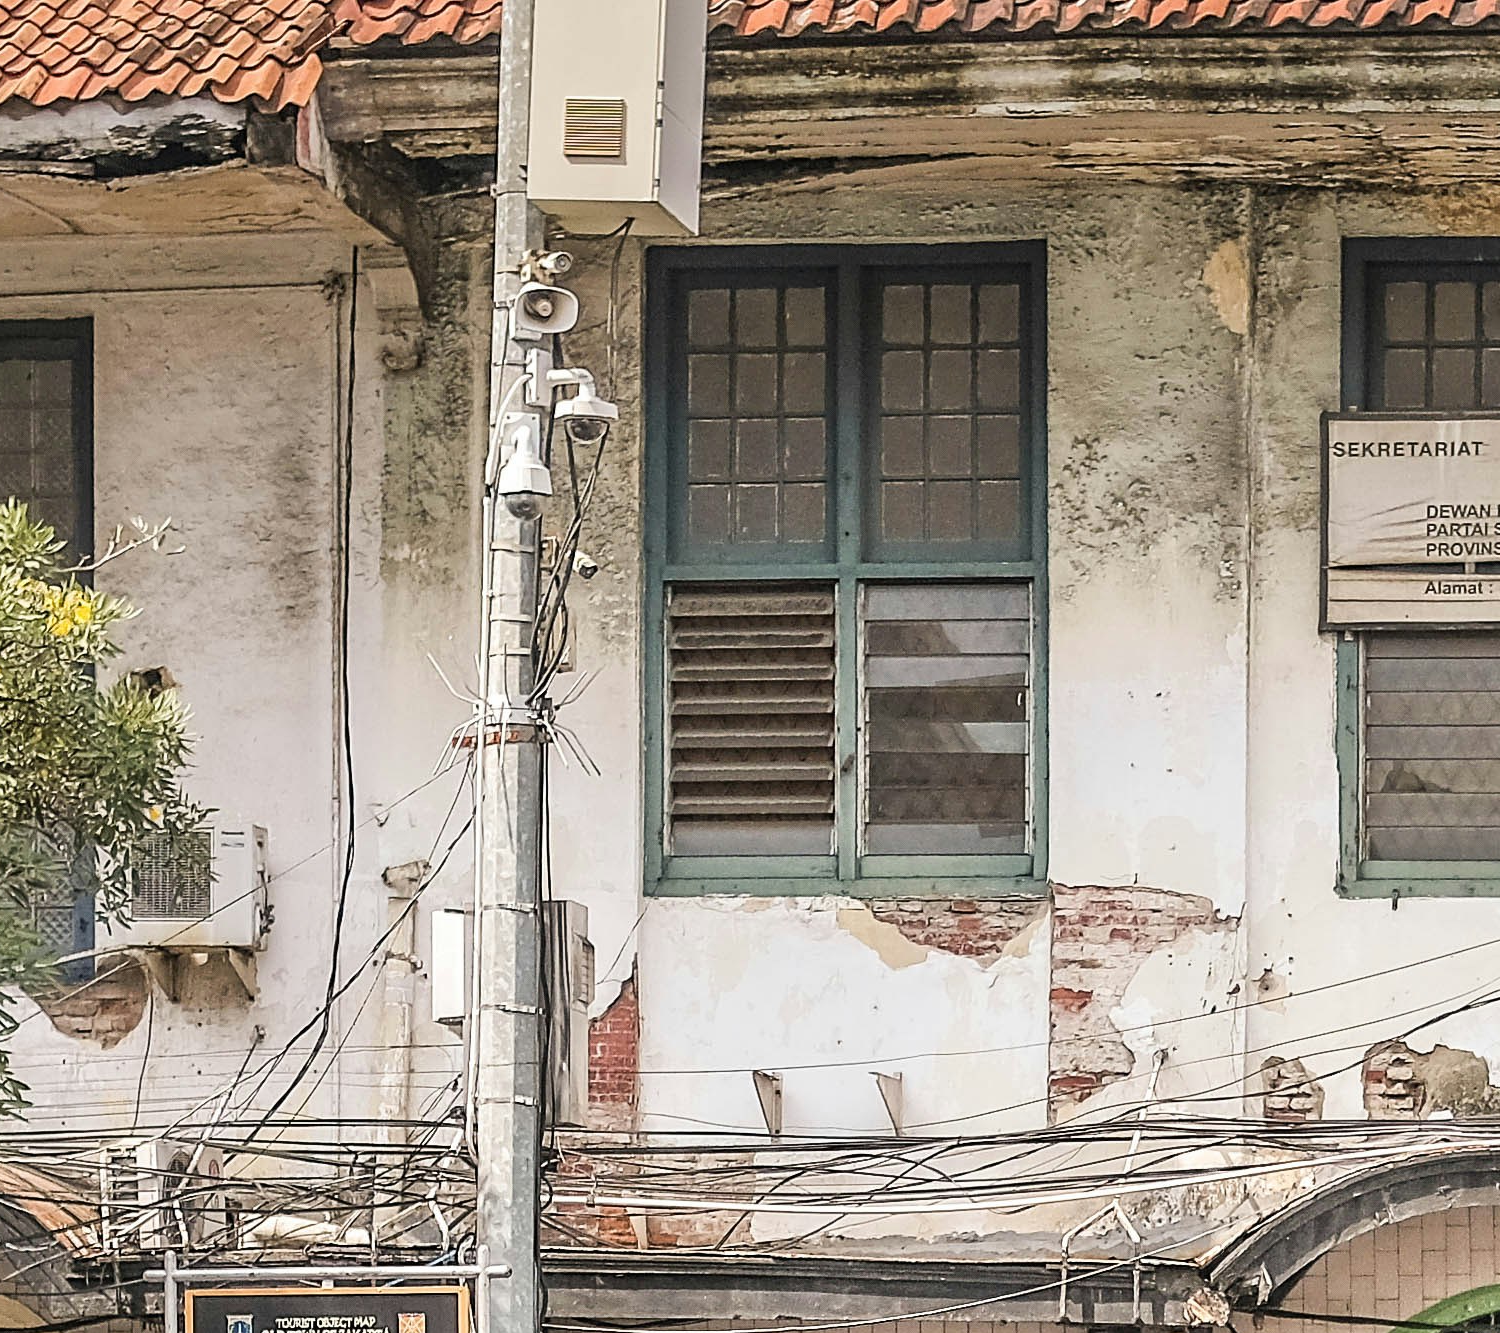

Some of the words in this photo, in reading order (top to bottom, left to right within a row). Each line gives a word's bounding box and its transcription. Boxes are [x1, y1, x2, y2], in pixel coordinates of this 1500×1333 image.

[1332, 441, 1484, 457] SEKRETARIAT
[1426, 504, 1491, 519] DEWAN
[1426, 523, 1488, 536] PARTAI
[1425, 582, 1483, 594] Alamat
[275, 1317, 315, 1328] TOURIST
[316, 1317, 352, 1328] OBJECT
[353, 1316, 376, 1328] MAP
